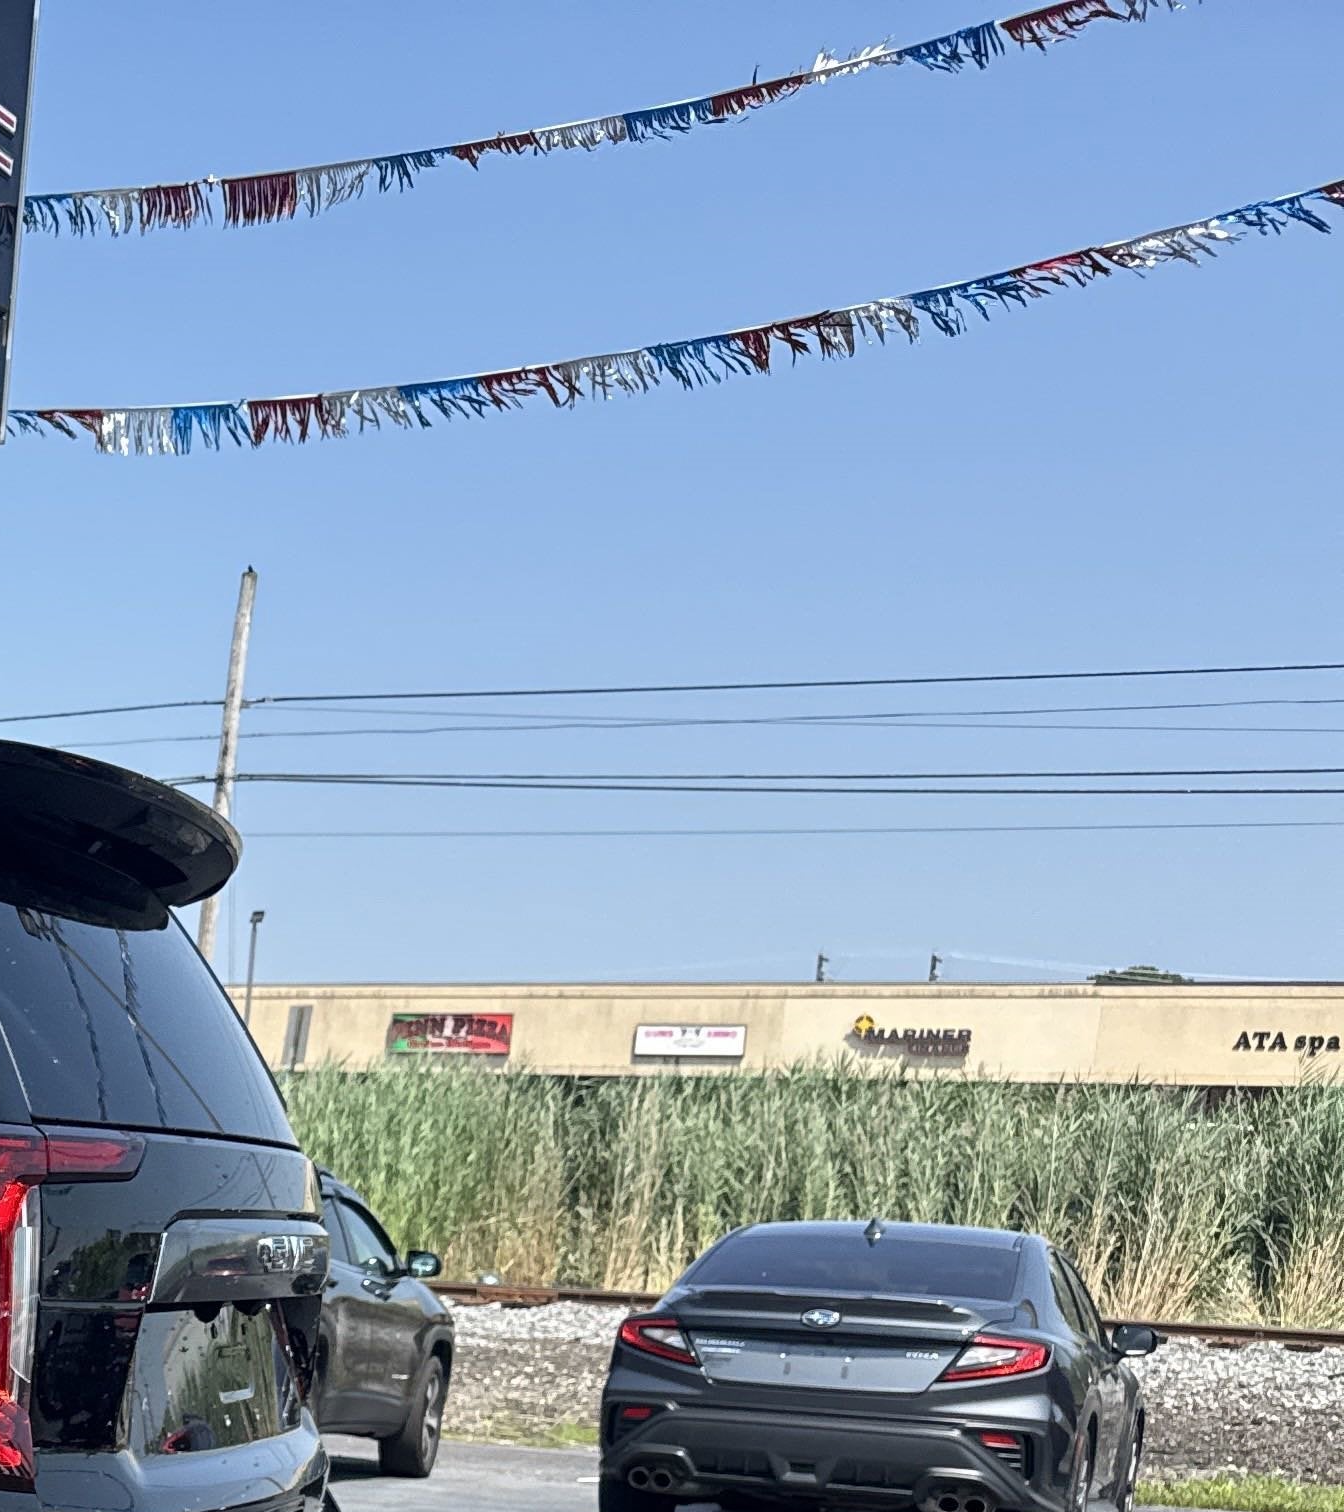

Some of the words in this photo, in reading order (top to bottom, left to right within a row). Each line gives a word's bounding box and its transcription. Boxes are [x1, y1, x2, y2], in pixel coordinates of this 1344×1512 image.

[863, 1028, 972, 1044] MARINER
[1231, 1031, 1288, 1051] ATA
[1293, 1035, 1341, 1058] spa
